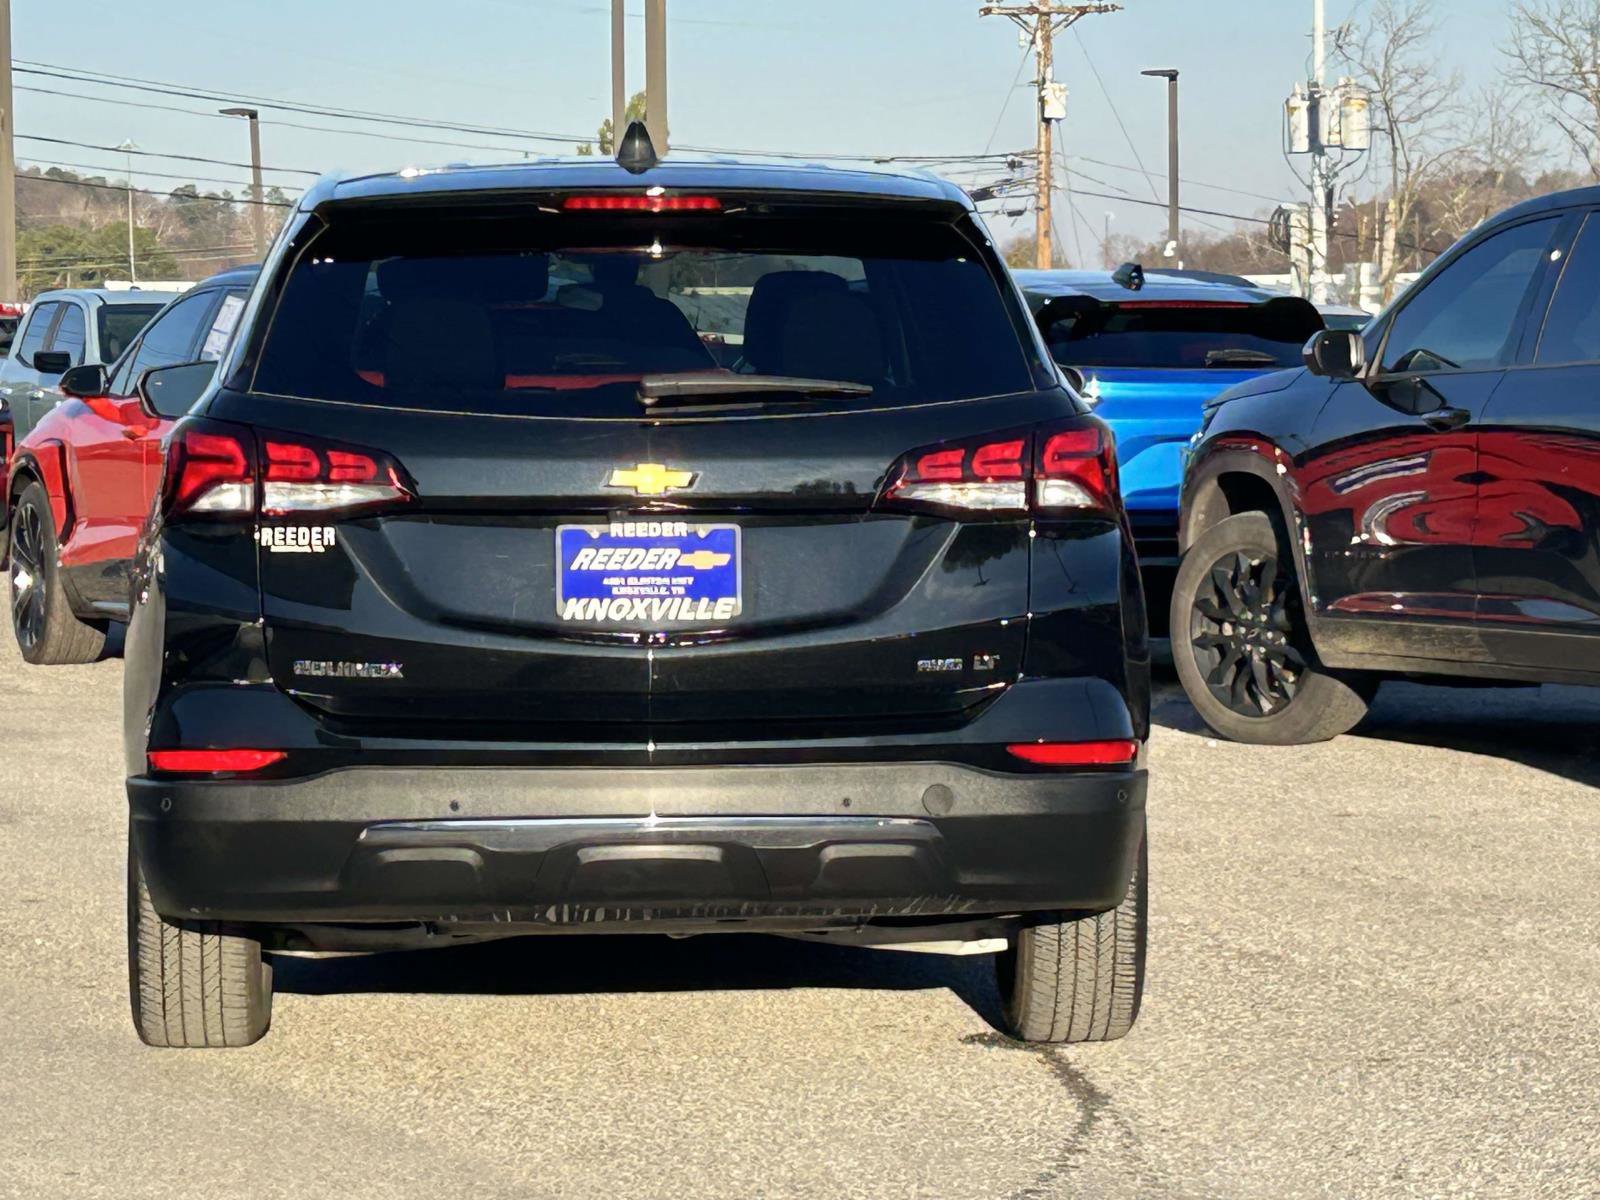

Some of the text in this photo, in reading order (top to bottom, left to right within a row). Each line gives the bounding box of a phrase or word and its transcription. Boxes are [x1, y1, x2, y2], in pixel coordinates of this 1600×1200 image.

[261, 526, 336, 547] REEDER
[610, 522, 689, 538] REEDER
[569, 548, 682, 571] REEDER
[563, 597, 737, 621] KNOXVILLE
